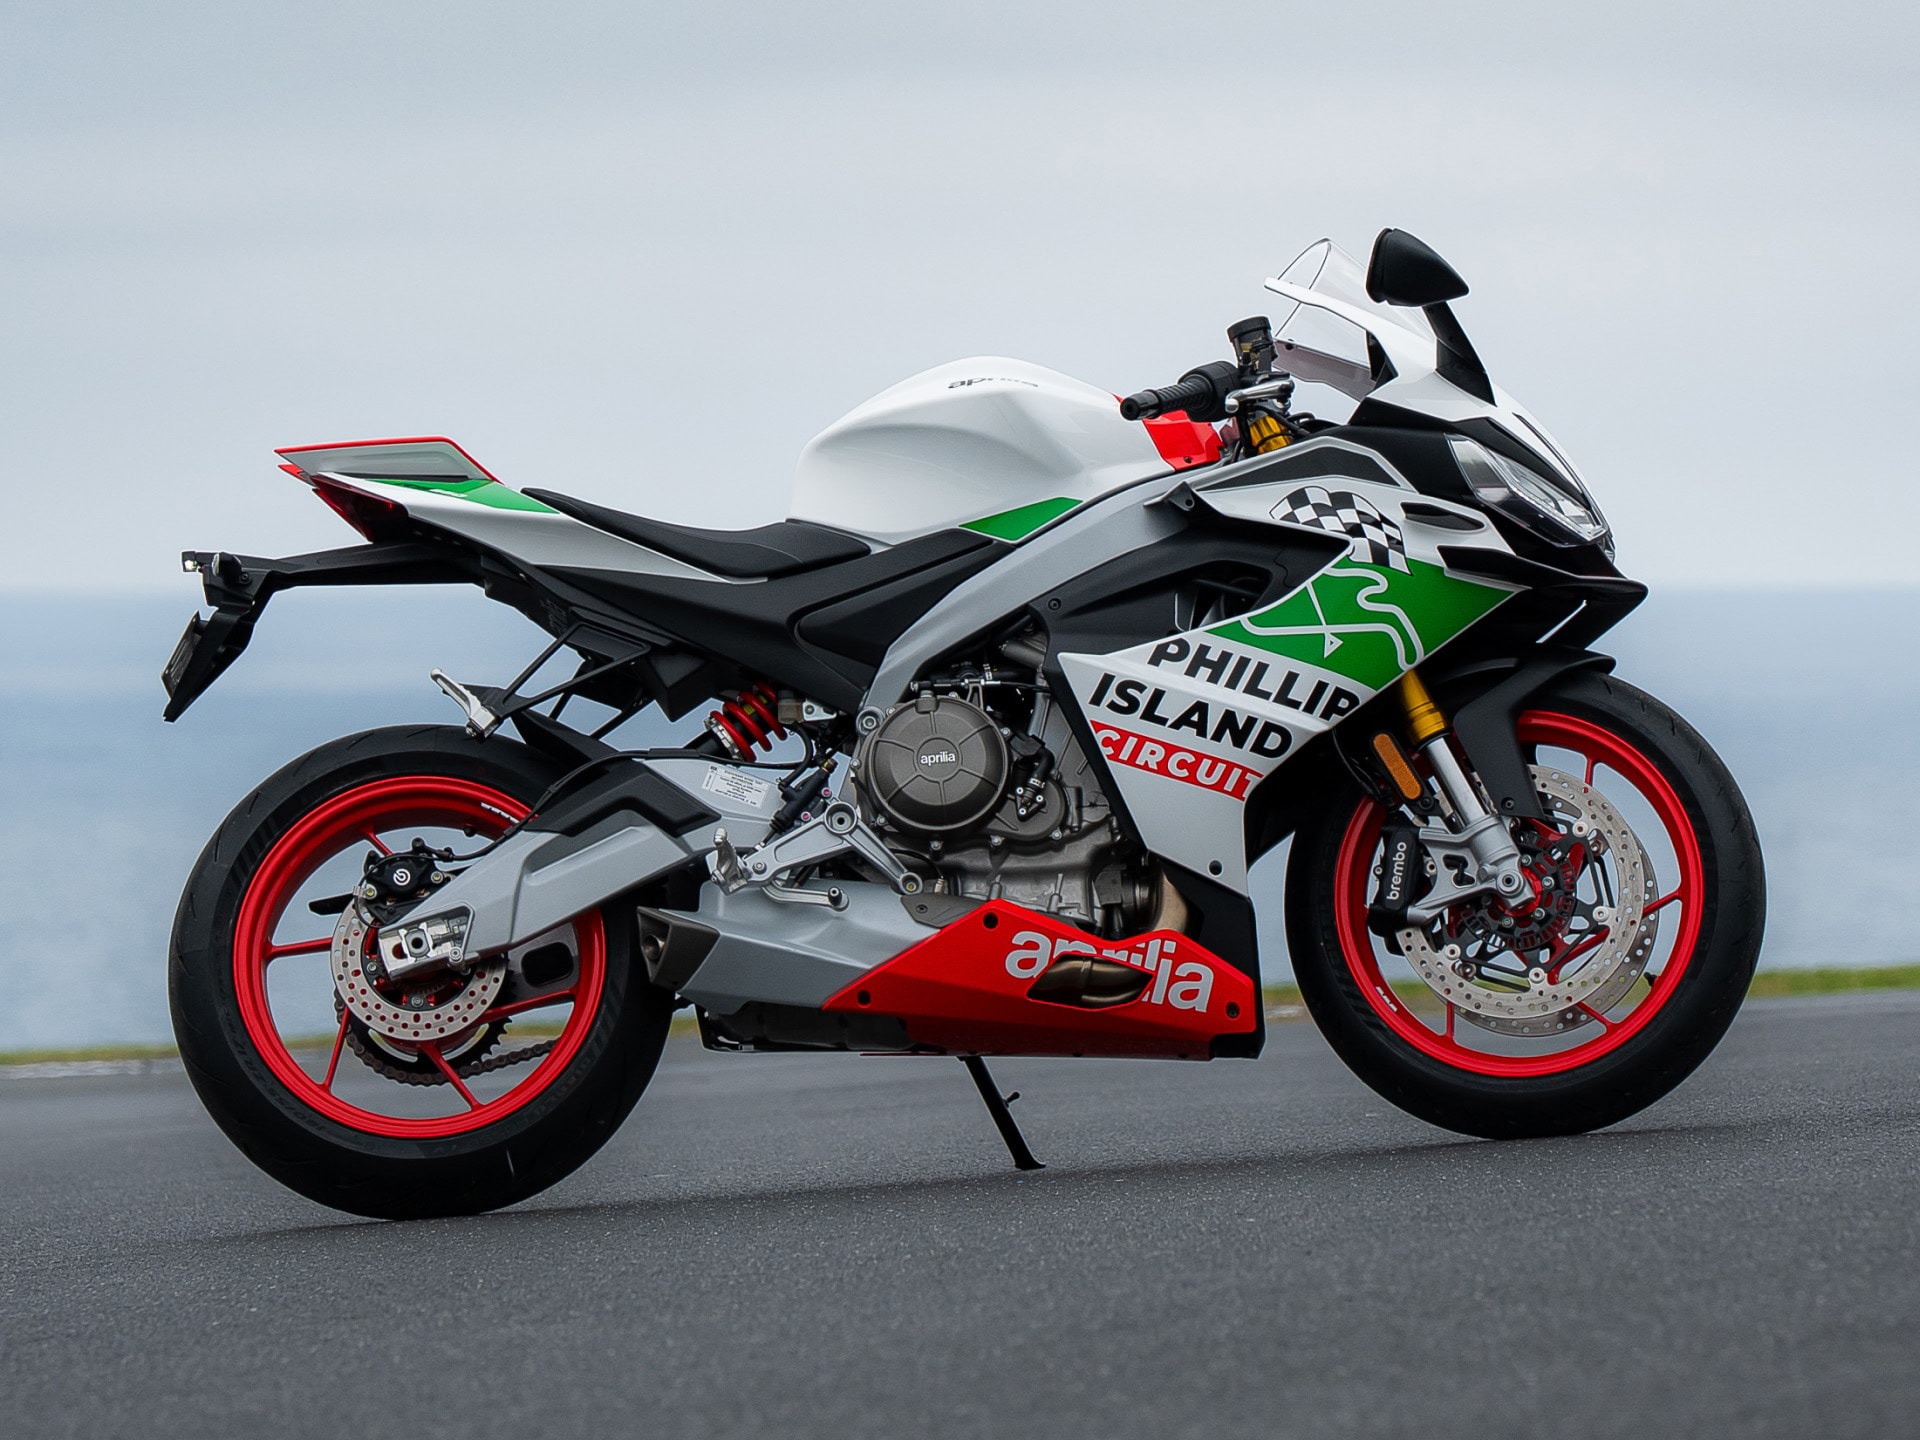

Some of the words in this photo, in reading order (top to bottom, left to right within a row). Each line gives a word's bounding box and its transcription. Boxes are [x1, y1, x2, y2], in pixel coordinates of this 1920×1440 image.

[1088, 672, 1294, 759] ISLAND
[1147, 637, 1361, 722] PHILLIP
[920, 751, 956, 767] aprilia
[1386, 841, 1407, 900] brembo
